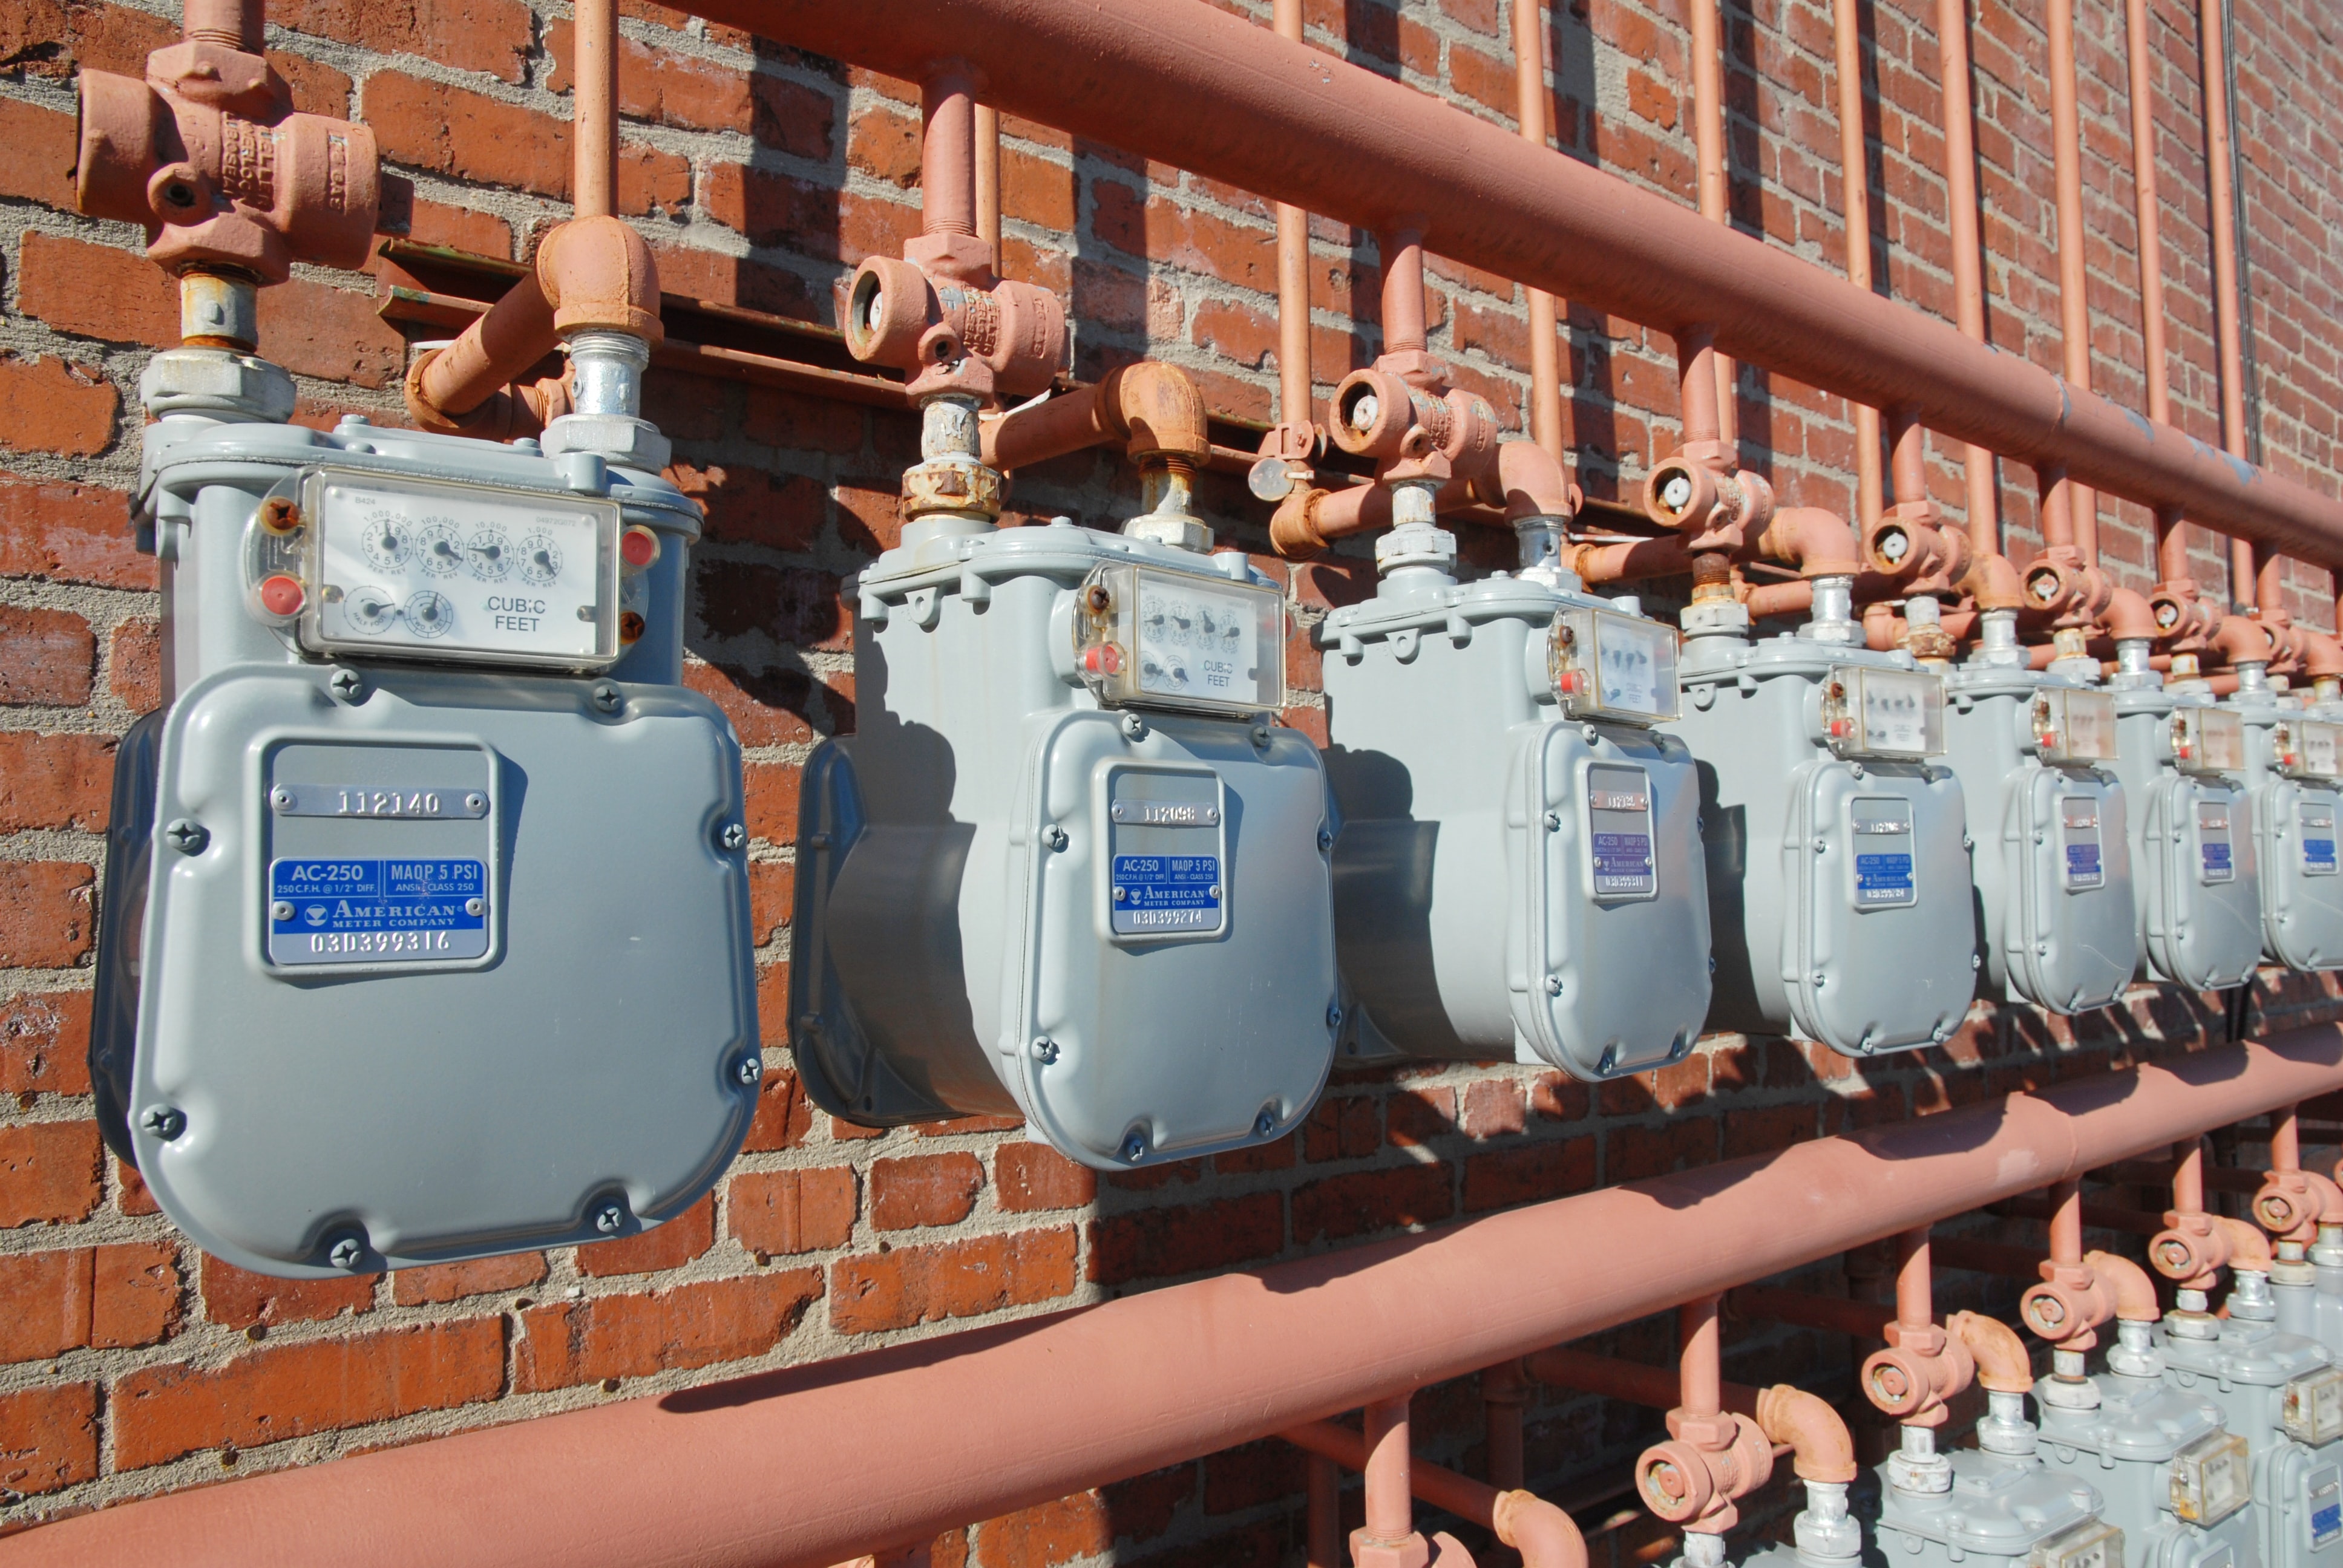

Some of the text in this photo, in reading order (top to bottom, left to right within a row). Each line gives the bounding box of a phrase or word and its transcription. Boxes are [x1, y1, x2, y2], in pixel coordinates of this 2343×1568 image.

[355, 497, 375, 505] B424
[386, 523, 392, 533] 0
[395, 527, 401, 535] 9
[437, 529, 443, 538] 0
[488, 534, 494, 542] 0
[402, 535, 408, 544] 8
[420, 537, 426, 546] 8
[454, 541, 460, 549] 2
[528, 540, 533, 549] 9
[404, 547, 409, 556] 7
[503, 545, 510, 554] 8
[384, 557, 390, 565] 5
[437, 561, 443, 570] 5
[447, 559, 453, 567] 4
[505, 557, 511, 566] 7
[368, 564, 383, 574] PER
[421, 568, 436, 579] PER
[527, 566, 533, 575] 6
[472, 572, 508, 584] PER REV
[537, 570, 542, 578] 5
[522, 577, 536, 587] PER
[488, 596, 546, 614] CUBIC
[353, 612, 386, 627] HALF FOOT
[413, 617, 445, 630] TWO FEET
[495, 615, 540, 632] FEET
[1204, 660, 1233, 674] CUBIC
[1207, 675, 1230, 687] FEET
[339, 791, 441, 814] 112140
[1123, 860, 1158, 871] AC-250
[1172, 860, 1215, 872] MAOP 5 PSI
[291, 865, 363, 881] AC-250
[391, 864, 477, 880] MAOP 5 PSI
[277, 884, 294, 893] 250
[310, 931, 450, 953] 03D399316
